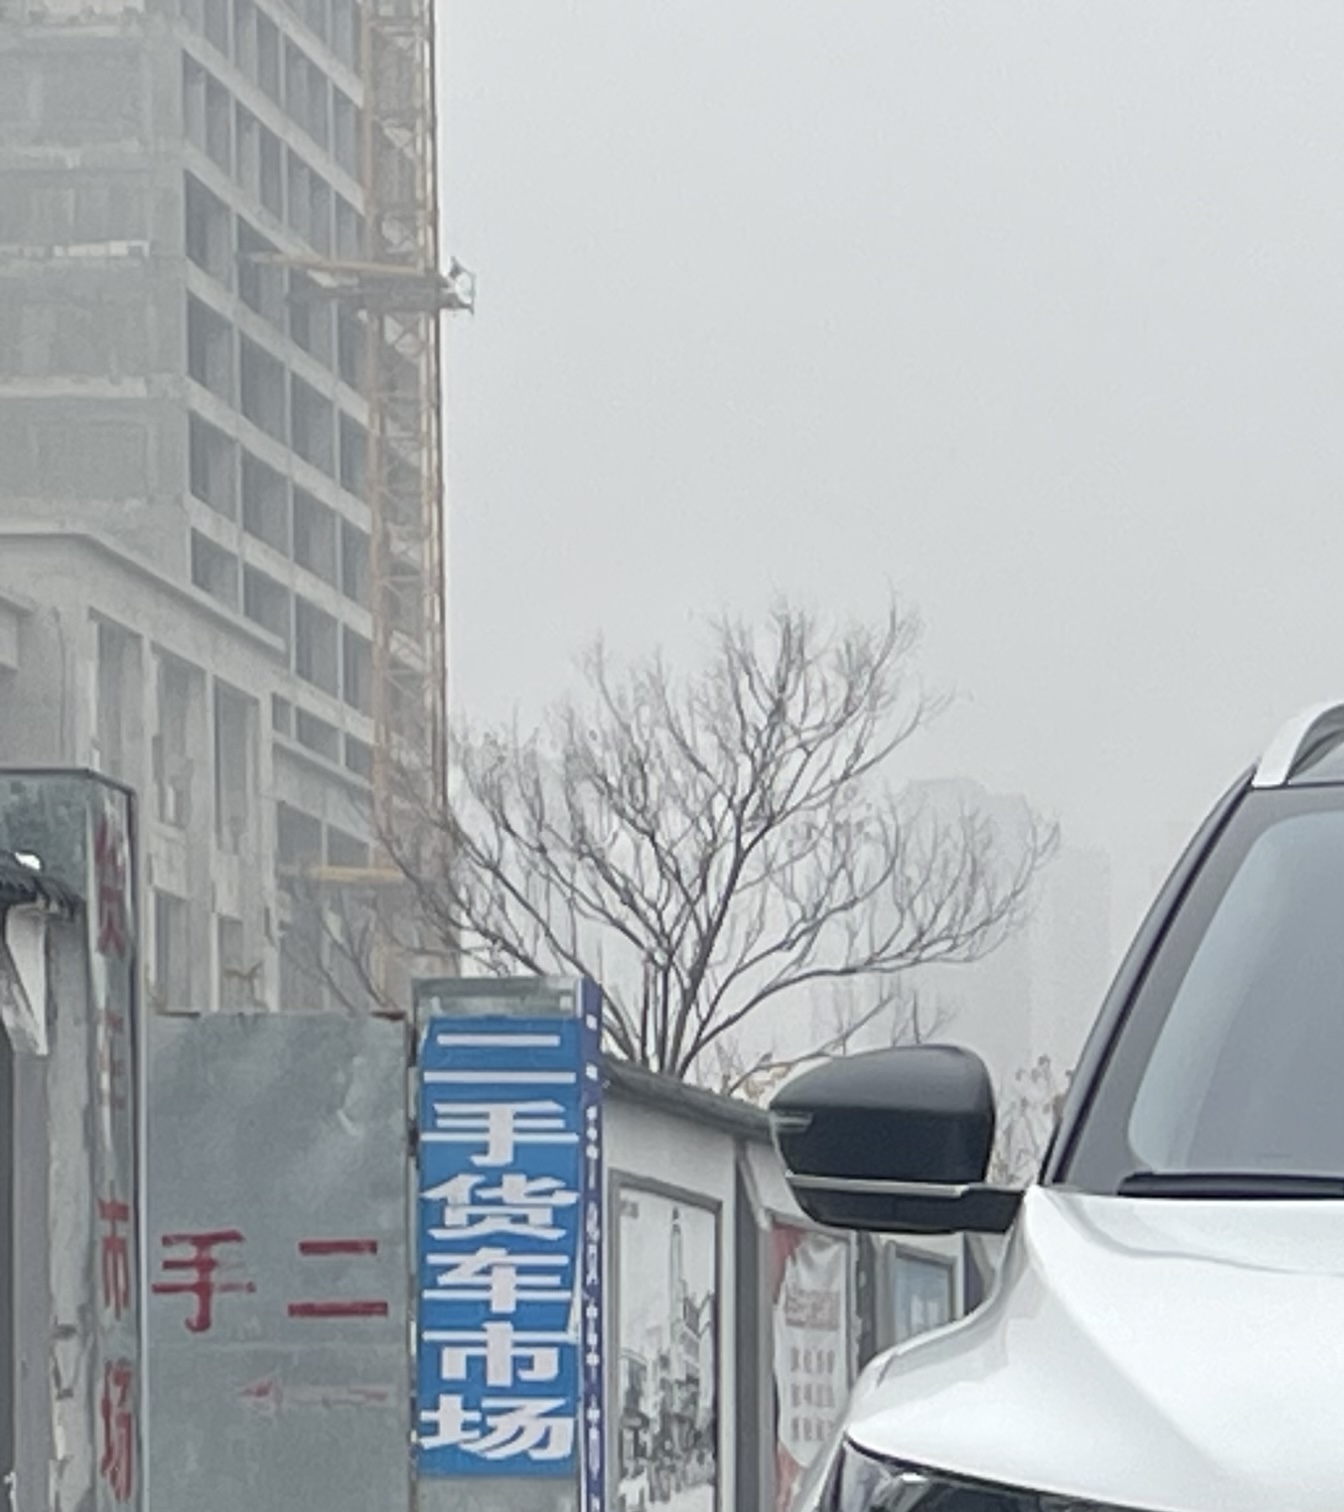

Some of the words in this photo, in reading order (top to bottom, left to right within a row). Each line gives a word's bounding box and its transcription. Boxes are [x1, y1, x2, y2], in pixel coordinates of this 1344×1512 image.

[419, 1032, 581, 1461] 二手货车市场
